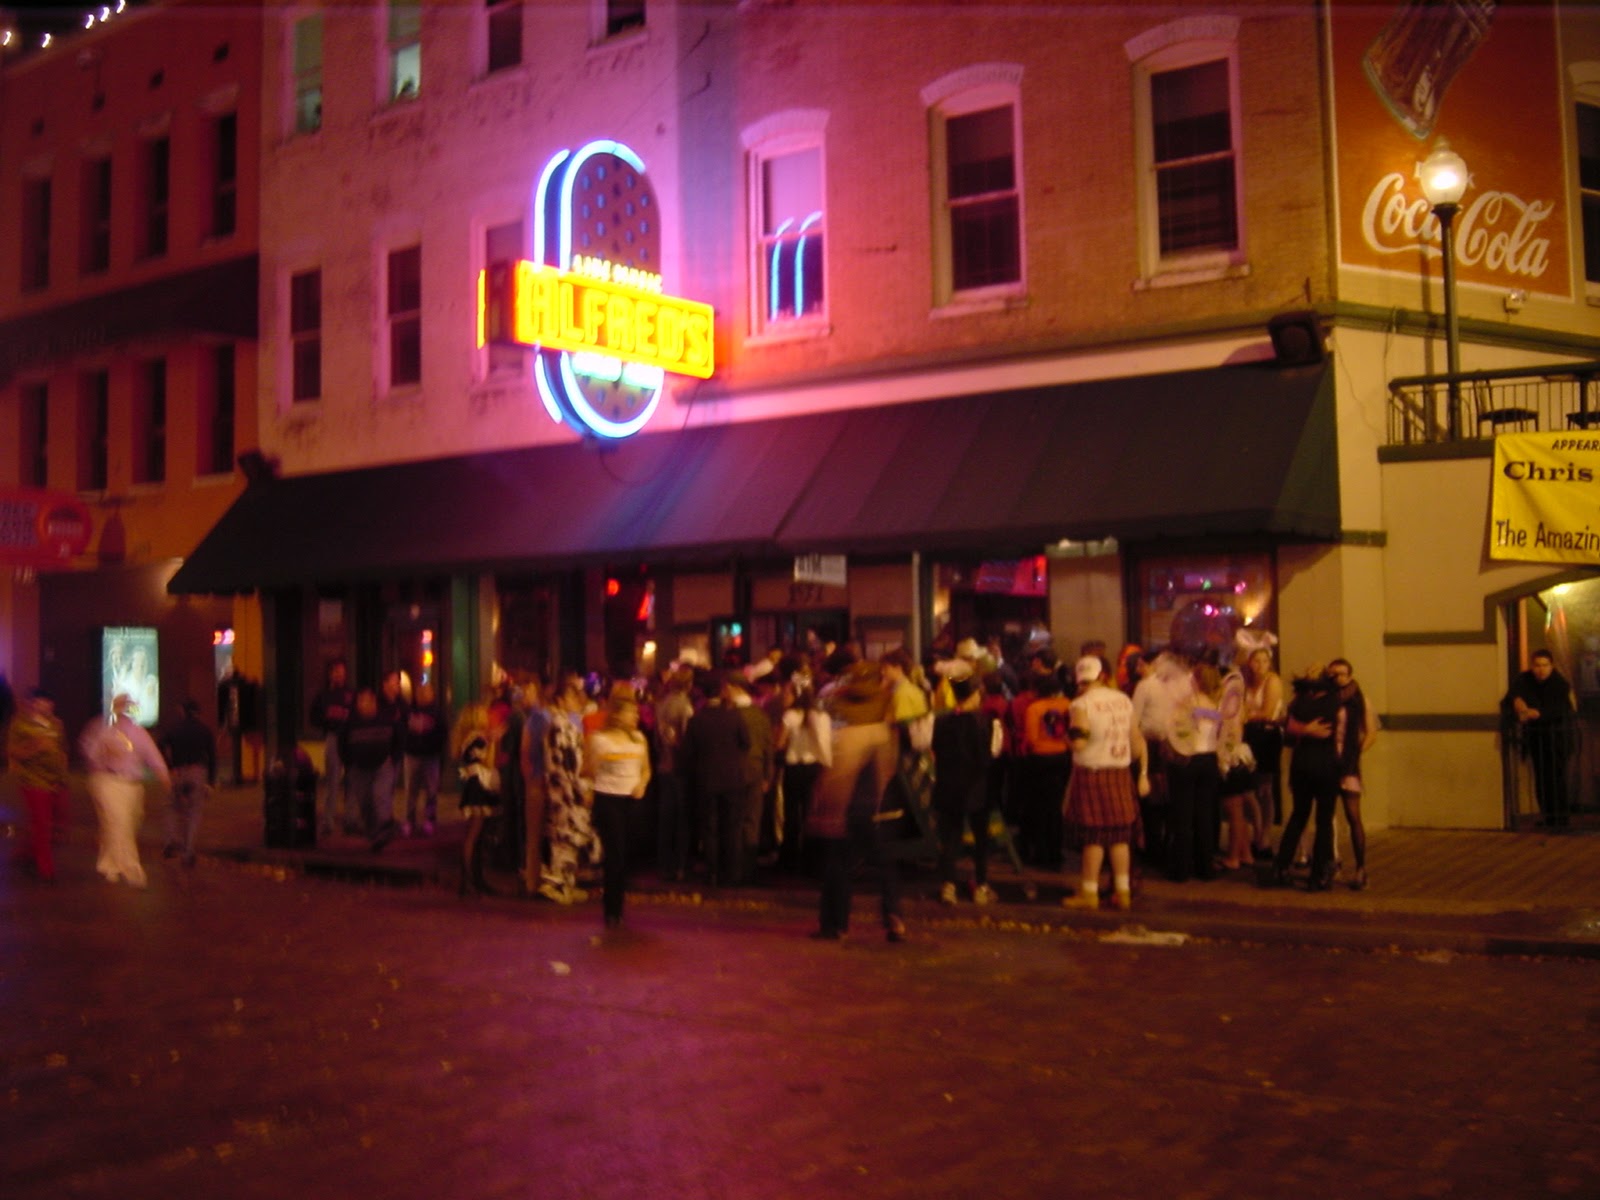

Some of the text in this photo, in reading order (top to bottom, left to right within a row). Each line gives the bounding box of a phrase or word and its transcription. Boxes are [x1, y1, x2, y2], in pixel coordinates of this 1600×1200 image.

[520, 273, 709, 368] ALFRED'S
[1551, 439, 1600, 451] APPEAR
[1503, 461, 1594, 483] Chris
[1496, 519, 1600, 554] The Amazin
